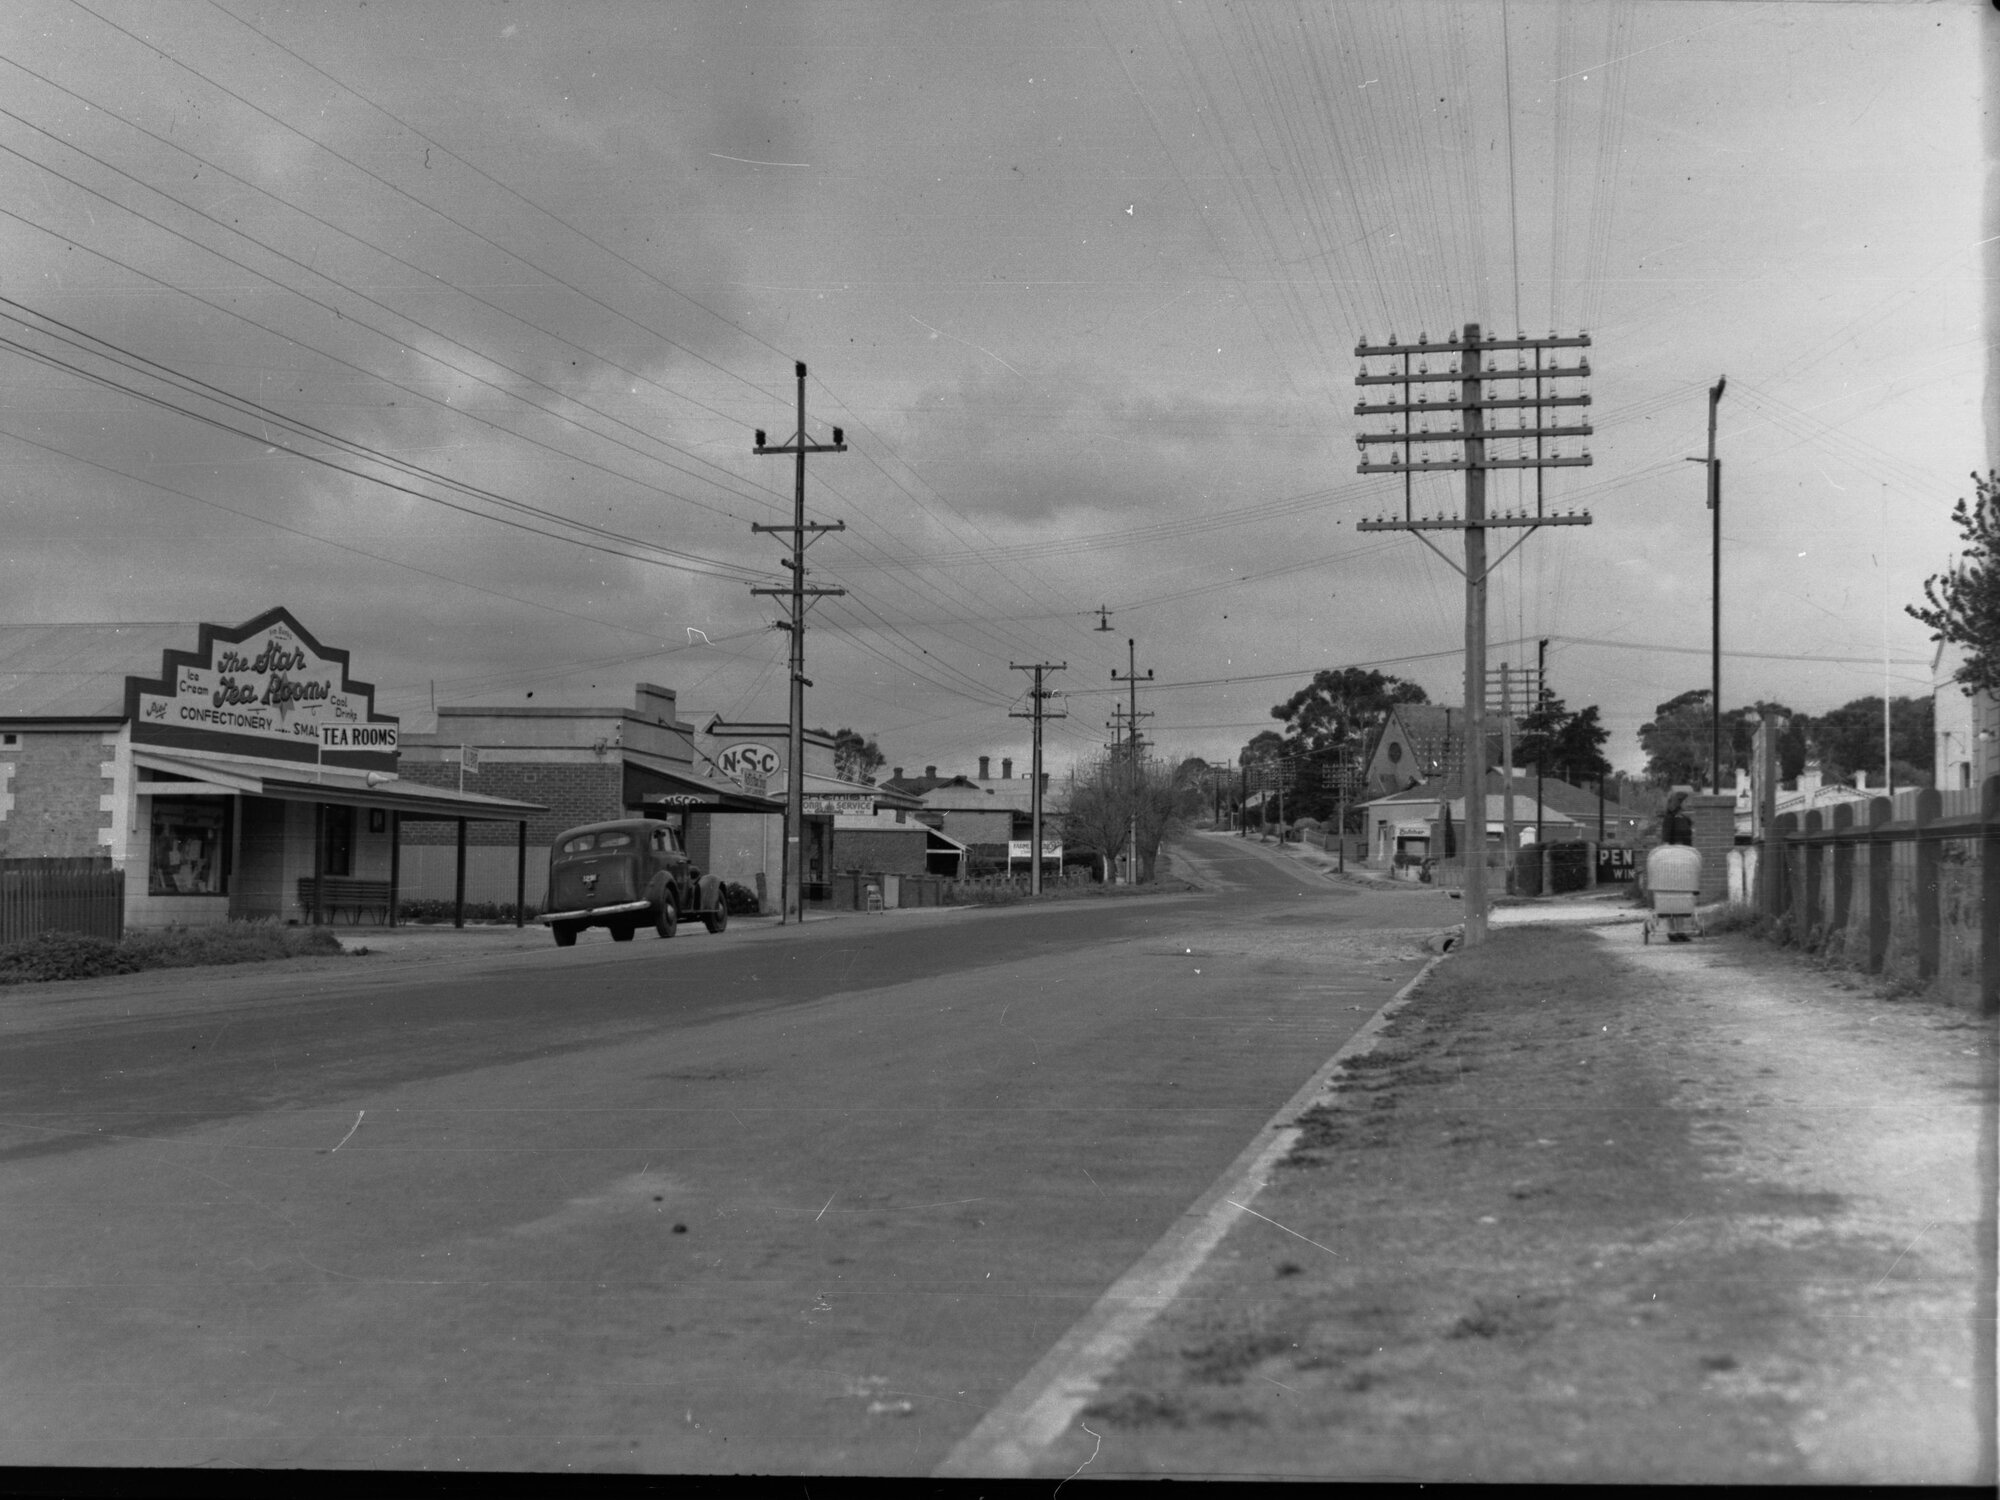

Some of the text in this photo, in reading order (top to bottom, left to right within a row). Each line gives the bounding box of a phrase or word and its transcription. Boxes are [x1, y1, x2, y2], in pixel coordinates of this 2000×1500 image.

[217, 640, 305, 675] The Star
[187, 669, 199, 682] Ice
[180, 681, 209, 696] Cream
[213, 673, 331, 708] Tea Rooms
[330, 696, 348, 708] Cool
[180, 706, 273, 732] CONFECTIONERY
[322, 727, 396, 746] TEA ROOMS
